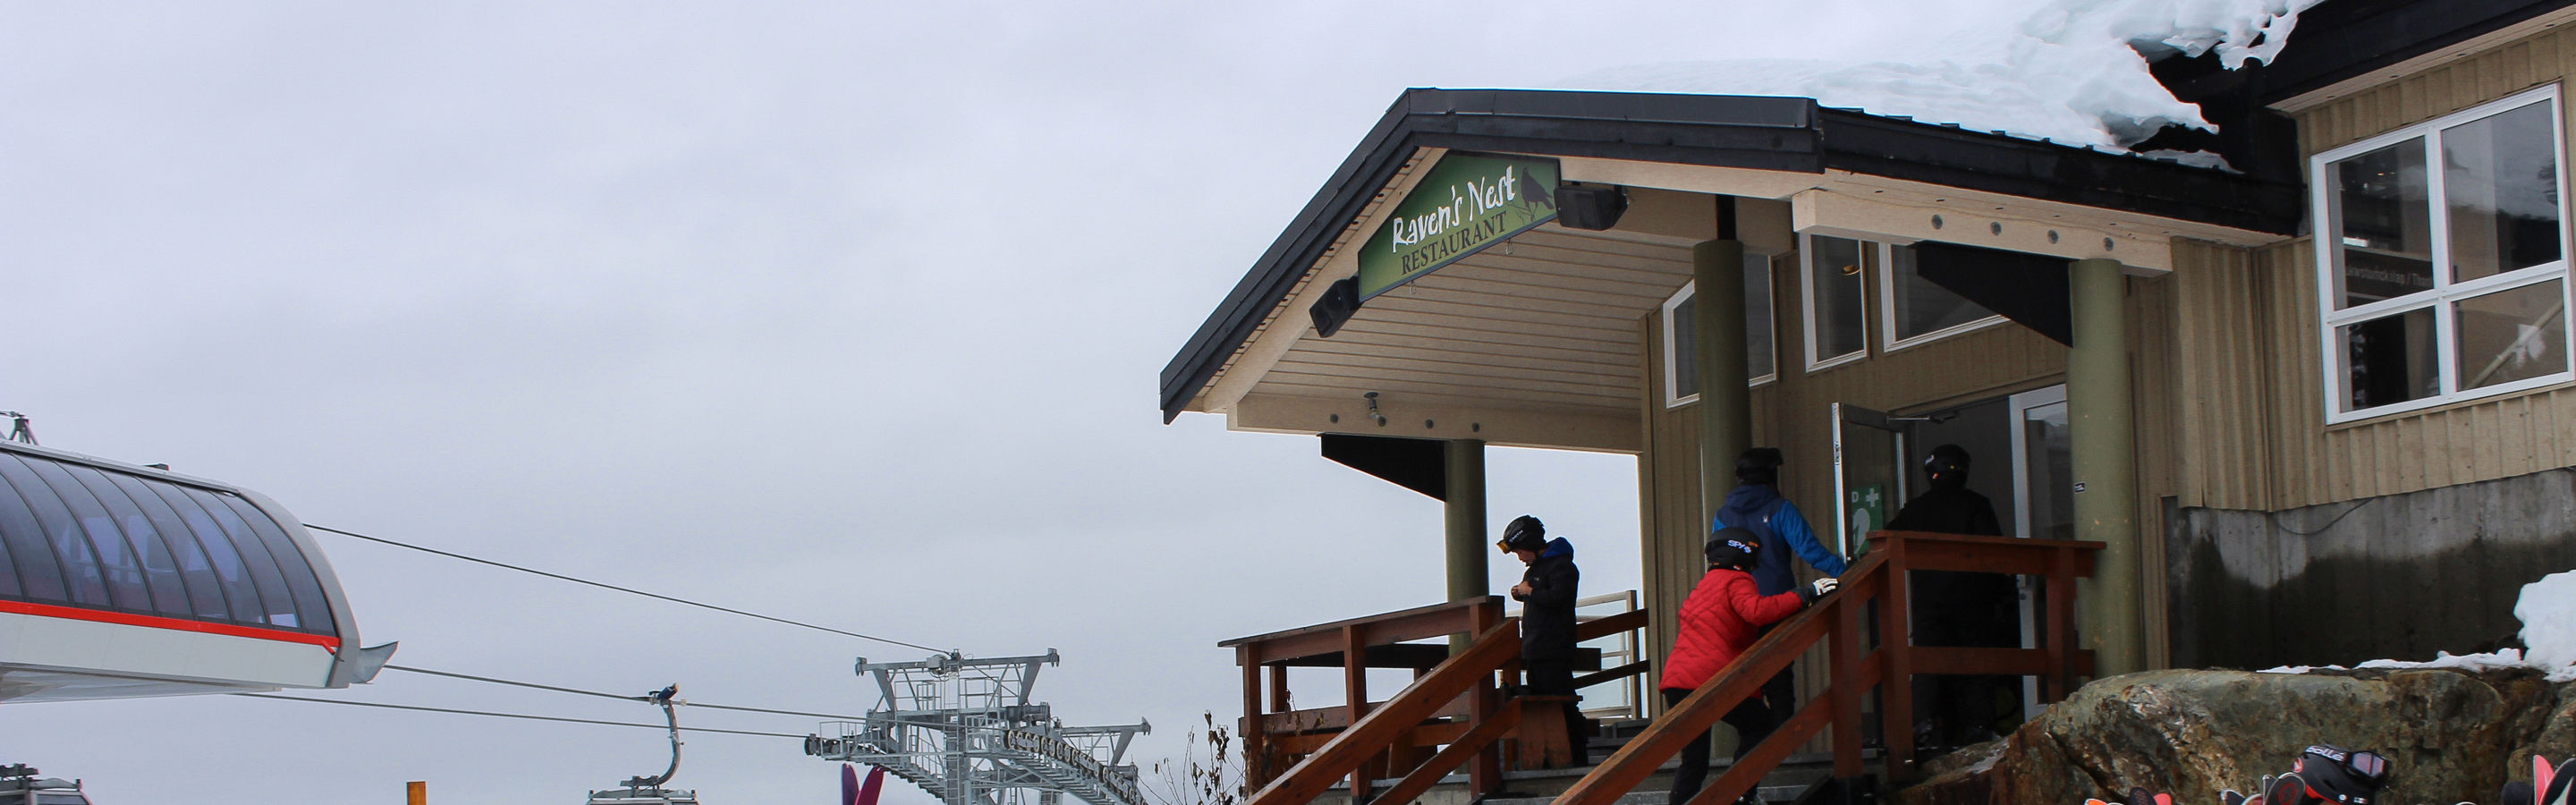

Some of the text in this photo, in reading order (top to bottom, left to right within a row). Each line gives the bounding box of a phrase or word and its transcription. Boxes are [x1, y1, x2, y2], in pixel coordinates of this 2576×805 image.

[1392, 165, 1516, 253] Raven's Nest
[1401, 210, 1507, 275] RESTAURANT
